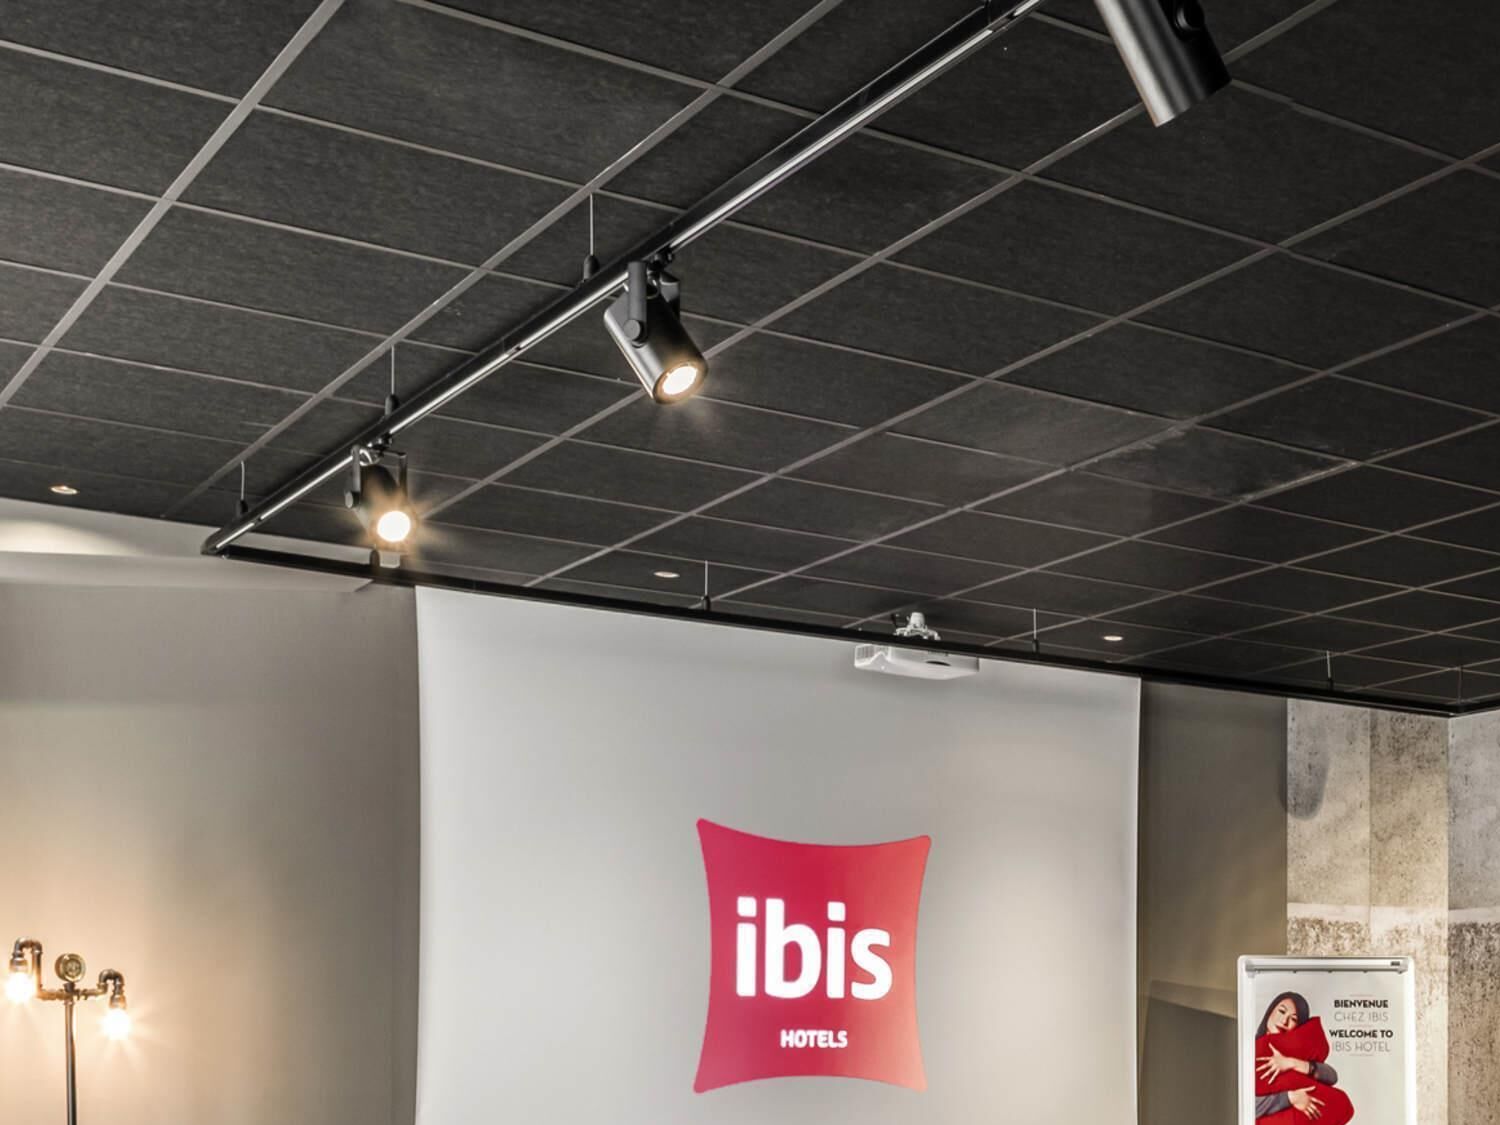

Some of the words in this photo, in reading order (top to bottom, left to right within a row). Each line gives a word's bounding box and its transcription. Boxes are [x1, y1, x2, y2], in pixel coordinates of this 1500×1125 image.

[736, 896, 893, 1001] ibis
[1334, 999, 1389, 1009] BIENVENUE
[1334, 1011, 1365, 1022] CHEZ
[1368, 1011, 1389, 1022] IBIS
[780, 1029, 848, 1048] HOTELS
[1329, 1029, 1378, 1038] WELCOME
[1380, 1029, 1394, 1038] TO
[1333, 1041, 1352, 1052] IBIS
[1354, 1041, 1391, 1052] HOTEL
